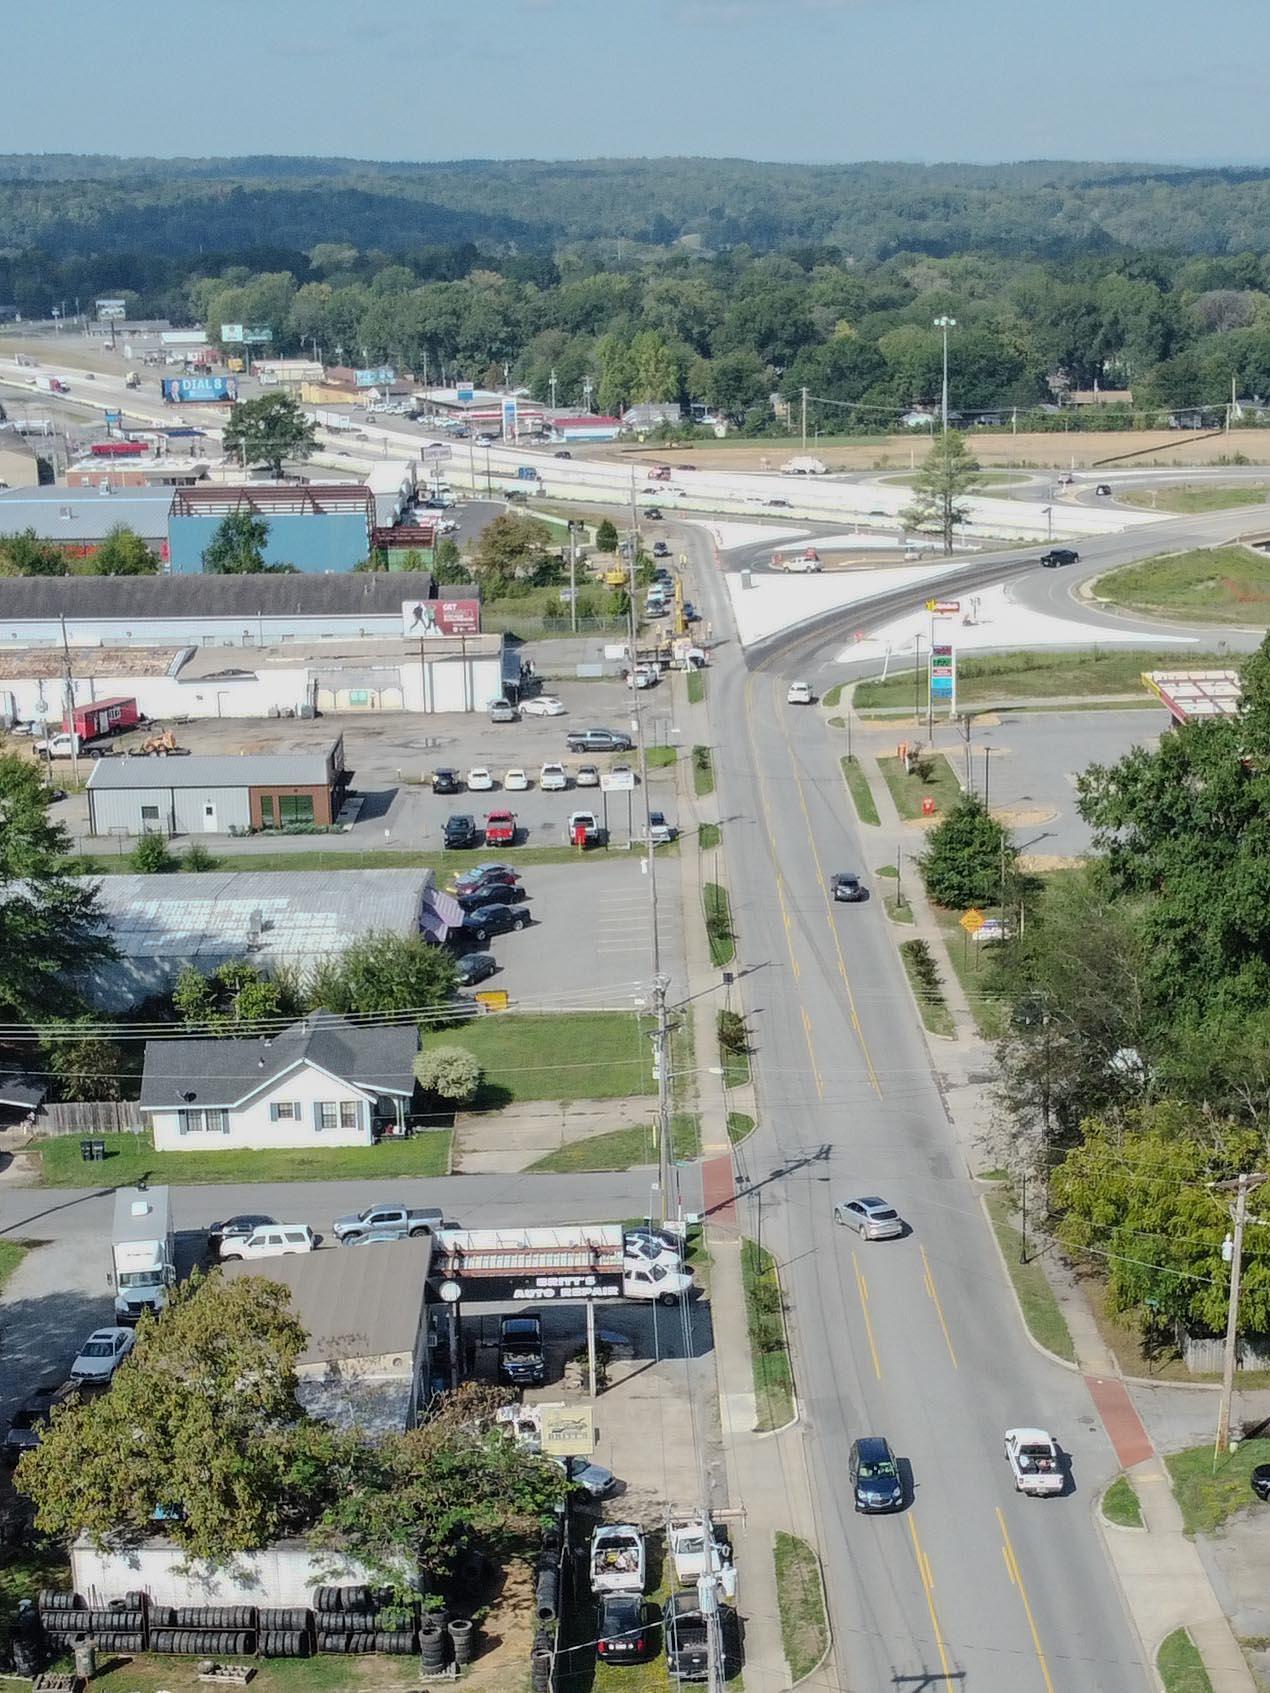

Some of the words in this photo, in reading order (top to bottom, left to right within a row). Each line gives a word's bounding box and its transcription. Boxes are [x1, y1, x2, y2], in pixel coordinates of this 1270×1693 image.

[182, 378, 212, 391] DIAL
[214, 378, 222, 390] 8
[513, 1288, 556, 1299] AUTO
[560, 1286, 619, 1297] REPAIR
